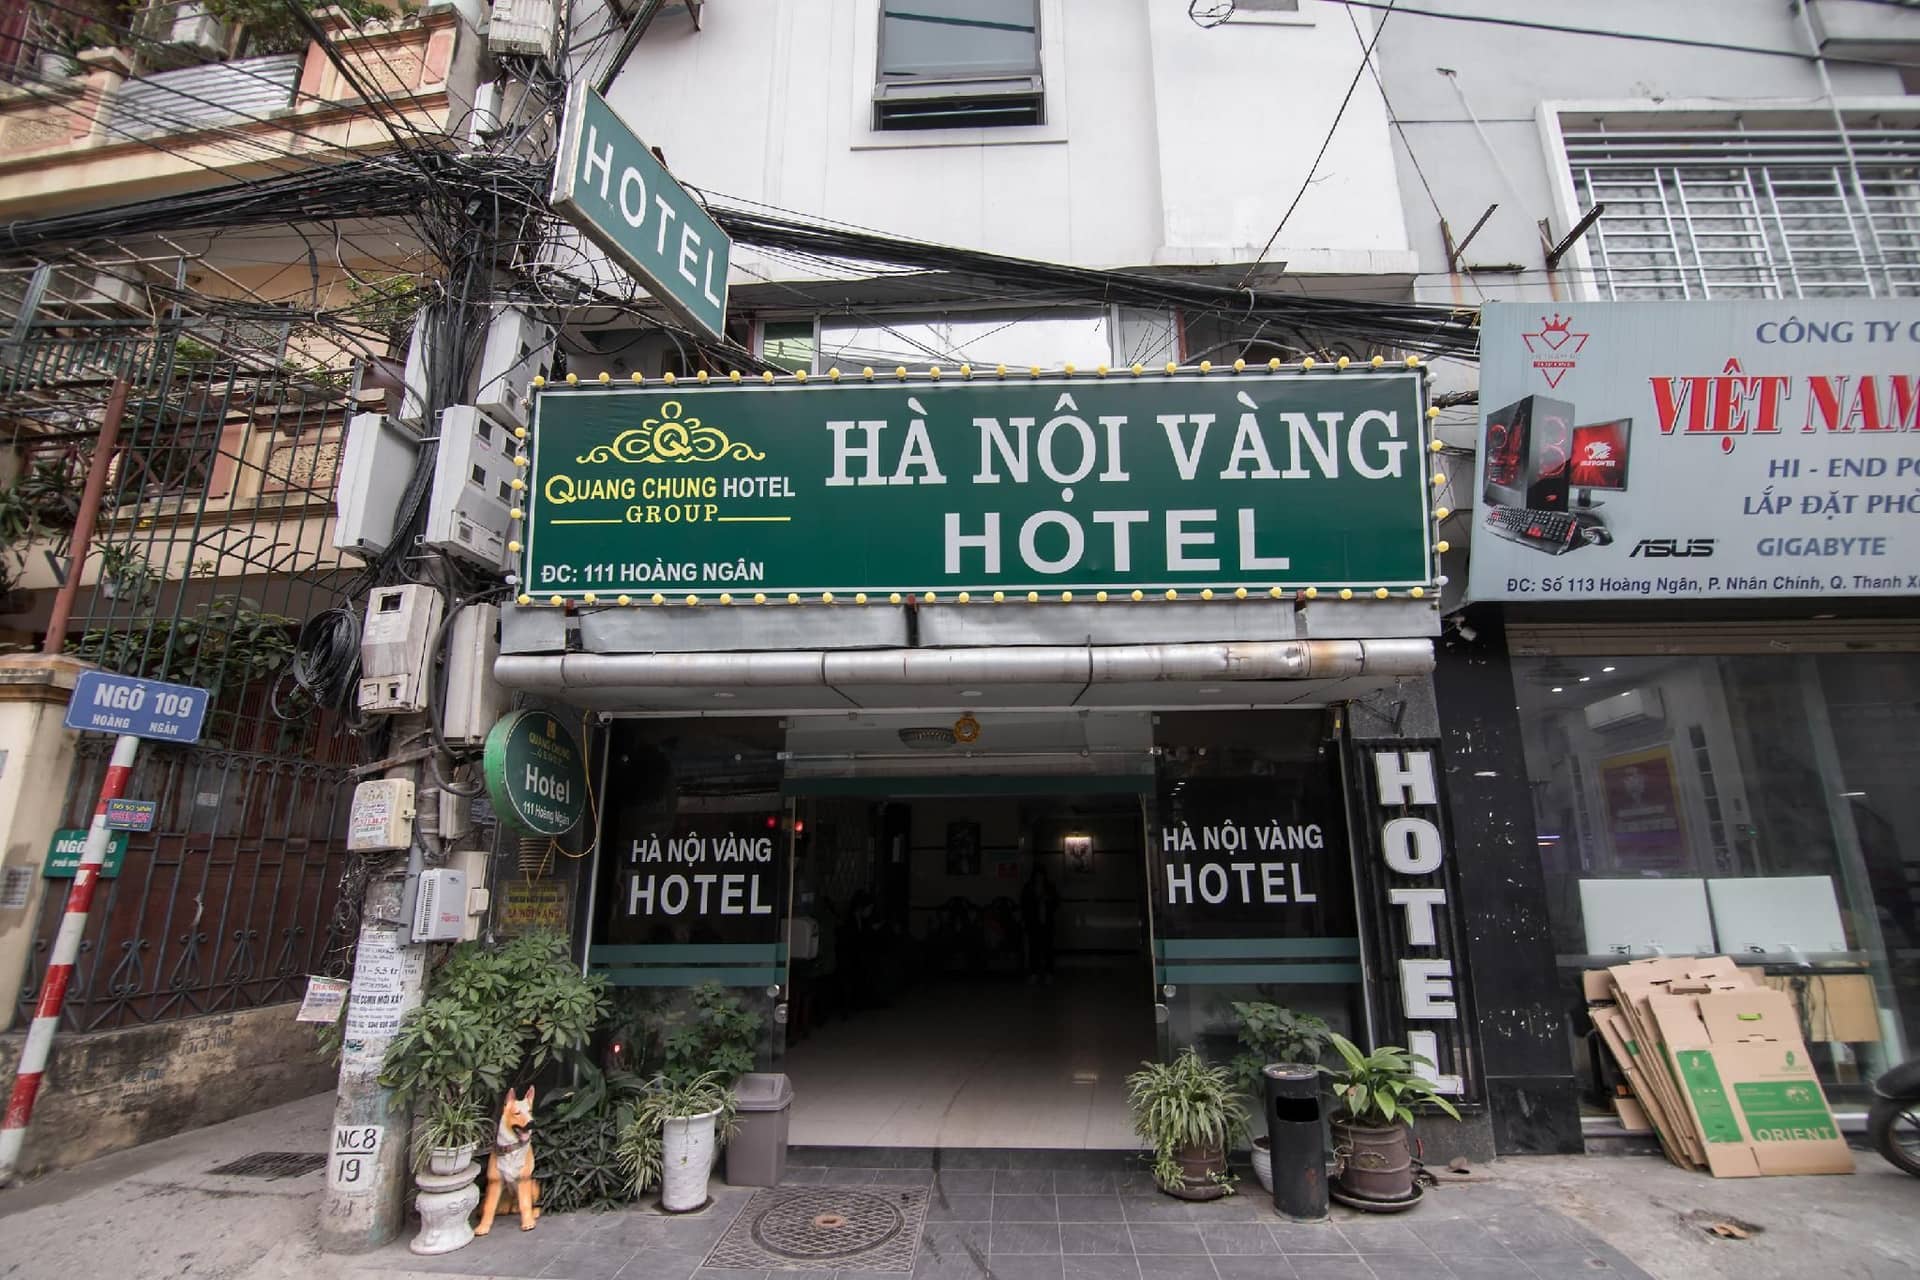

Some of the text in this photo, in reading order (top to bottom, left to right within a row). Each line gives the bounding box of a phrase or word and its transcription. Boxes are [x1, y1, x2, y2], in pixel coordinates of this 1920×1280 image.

[584, 124, 720, 309] HOTEL
[1757, 316, 1854, 343] CÔNG
[1864, 321, 1901, 343] TY
[1648, 357, 1920, 454] VIỆT NAM
[825, 390, 1408, 502] HÀ NỘI VÀNG
[1769, 458, 1800, 478] HI
[1828, 457, 1887, 478] END
[545, 474, 795, 504] QUANG CHUNG HOTEL
[1743, 485, 1793, 515] LẮP
[1800, 490, 1859, 521] ĐẶT
[626, 504, 719, 524] GROUP
[944, 508, 1291, 574] HOTEL
[1628, 538, 1715, 558] ASUS
[1757, 537, 1887, 557] GIGABYTE
[541, 557, 764, 583] ĐC: 111 HOÀNG NGÂN
[1507, 578, 1536, 592] ĐC:
[1541, 576, 1564, 592] Số
[1568, 578, 1594, 592] 113
[1600, 577, 1651, 594] Hoàng
[1656, 576, 1702, 594] Ngân,
[1708, 577, 1721, 591] P.
[1726, 576, 1768, 590] Nhân
[1773, 575, 1824, 592] Chính,
[1830, 576, 1847, 591] Q.
[1853, 575, 1902, 589] Thanh
[93, 682, 194, 718] NGÕ 109
[92, 713, 179, 735] HOÀNG NGÂN
[525, 763, 570, 805] Hotel
[521, 801, 534, 816] 111
[631, 832, 772, 867] HÀ NỘI VÀNG
[1162, 819, 1324, 855] HÀ NỘI VÀNG
[628, 874, 772, 915] HOTEL
[1166, 862, 1317, 904] HOTEL
[1374, 751, 1465, 1095] HOTEL
[336, 1128, 376, 1150] NC8
[1757, 1127, 1832, 1142] ORIENT
[338, 1158, 361, 1183] 19
